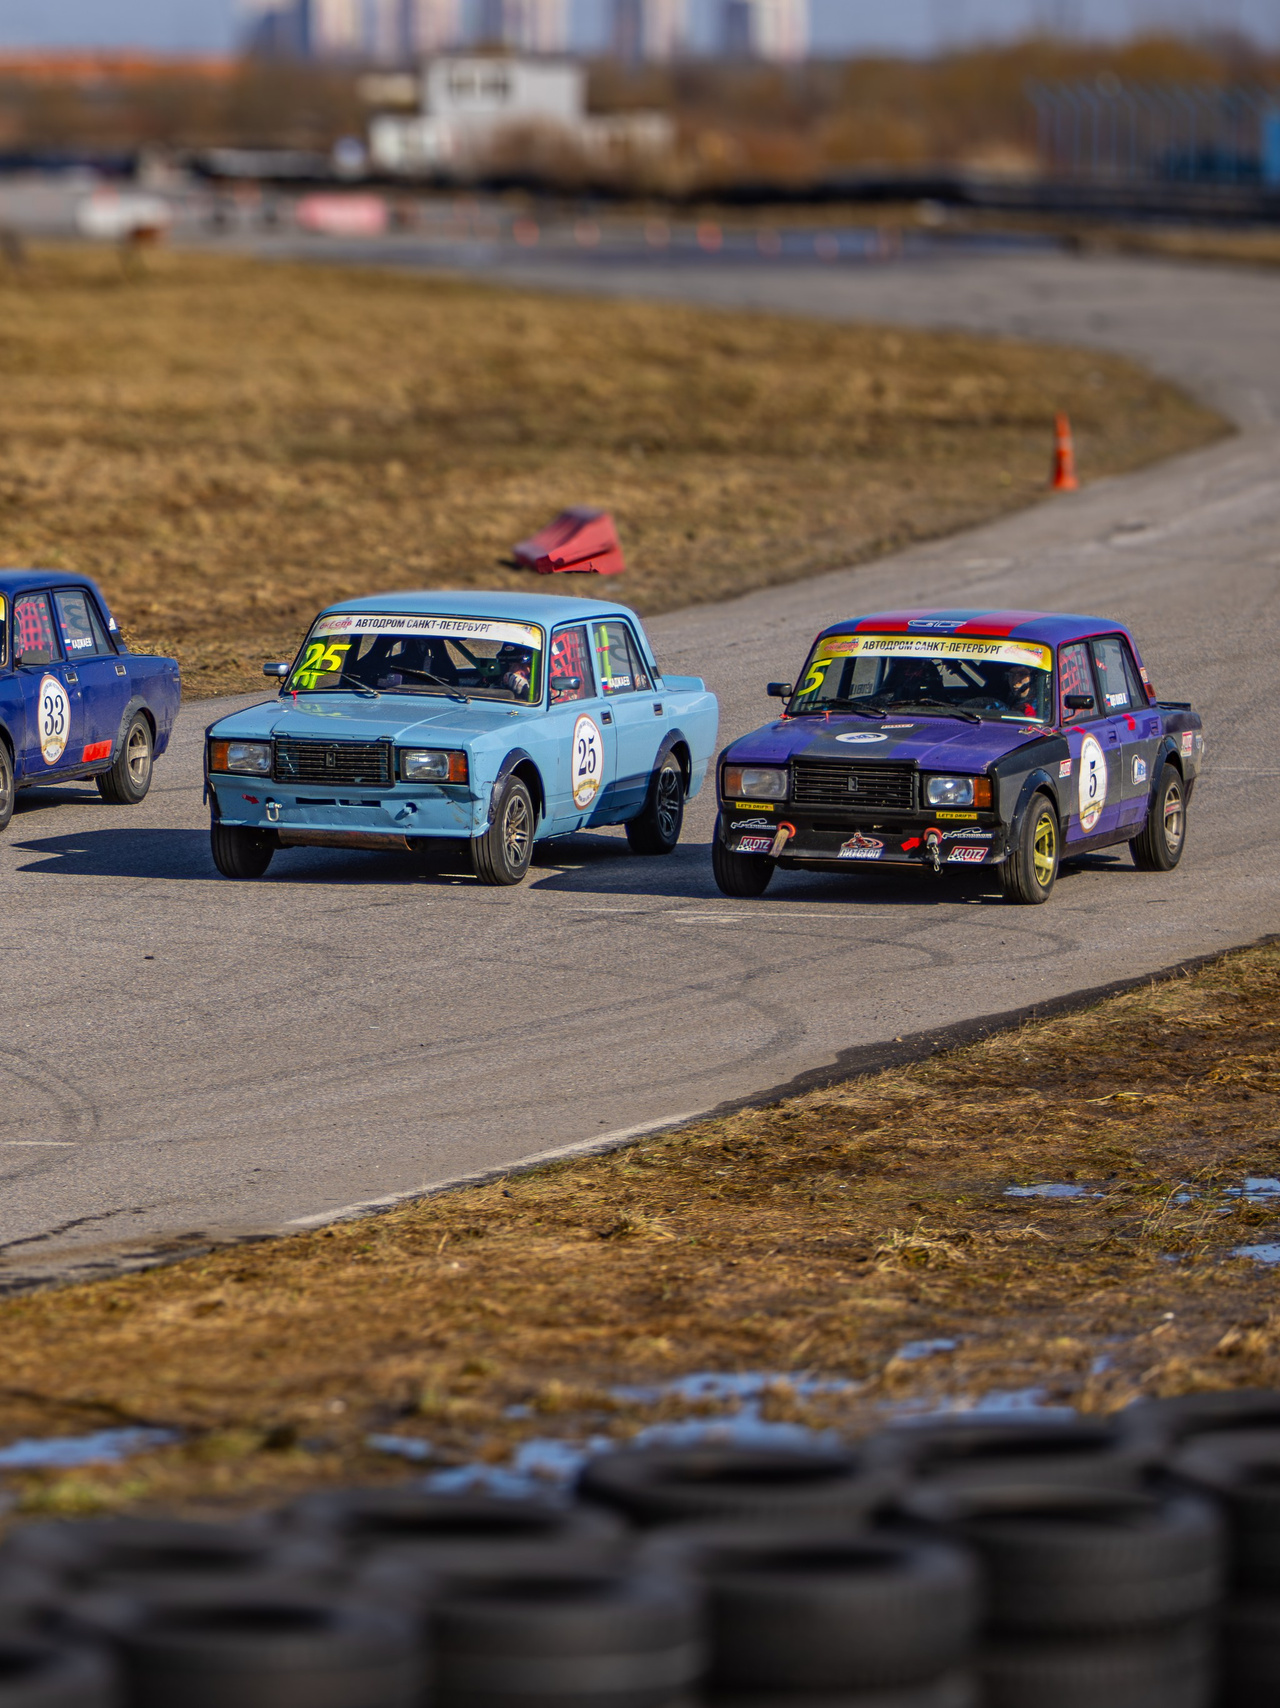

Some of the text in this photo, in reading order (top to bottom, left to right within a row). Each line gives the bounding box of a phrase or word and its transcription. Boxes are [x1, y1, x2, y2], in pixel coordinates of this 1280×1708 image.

[355, 618, 493, 633] АВТОДРОМ САНКТ-ПЕТЕРБУРГ
[291, 643, 353, 678] 25
[861, 640, 913, 651] АВТОДРОМ
[914, 640, 1003, 655] САНКТ-ПЕТЕРБУРГ
[796, 658, 833, 697] 5
[44, 694, 65, 737] 33
[577, 735, 597, 777] 25
[1088, 760, 1098, 799] 5
[742, 838, 771, 849] KLOTZ
[952, 848, 985, 859] KLOTZ
